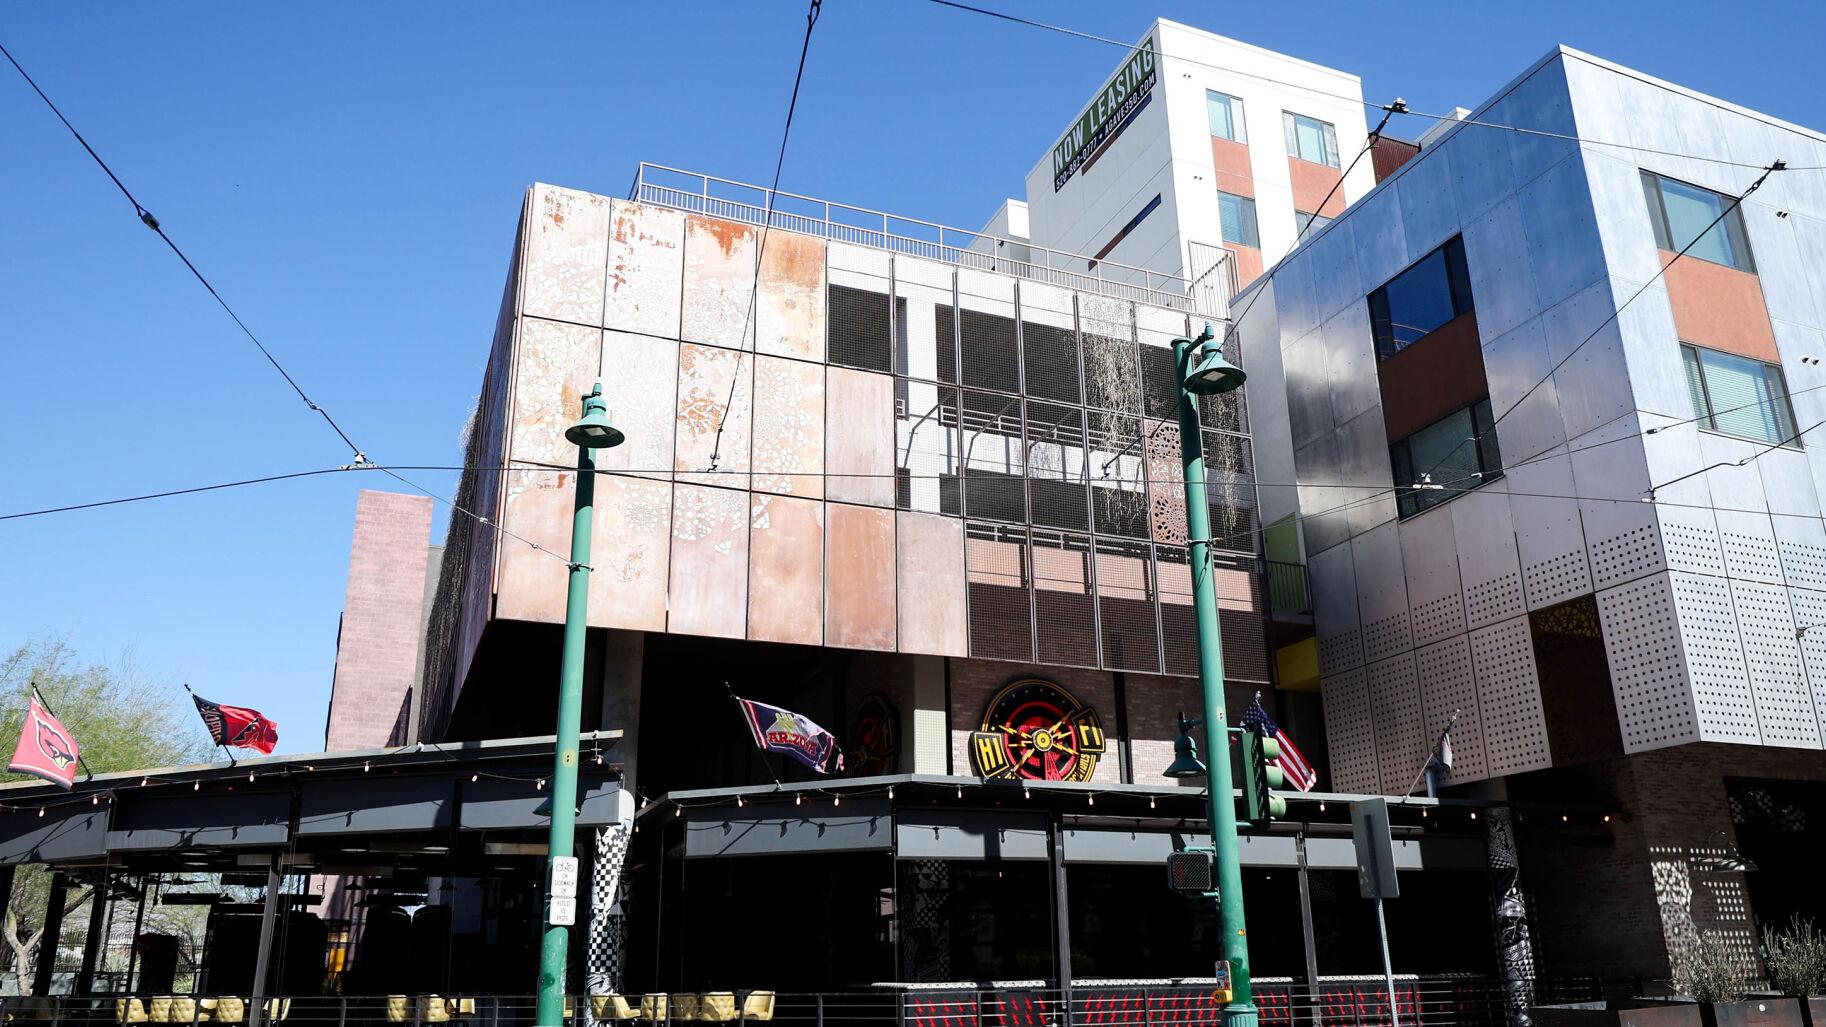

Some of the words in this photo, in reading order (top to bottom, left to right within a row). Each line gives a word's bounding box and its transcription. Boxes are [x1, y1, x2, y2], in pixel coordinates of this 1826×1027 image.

[1055, 119, 1084, 174] NOW
[1089, 43, 1153, 134] LEASING
[1056, 136, 1098, 190] 520-882-0777
[1104, 72, 1155, 134] AGAVE350.COM
[978, 737, 1004, 772] HI
